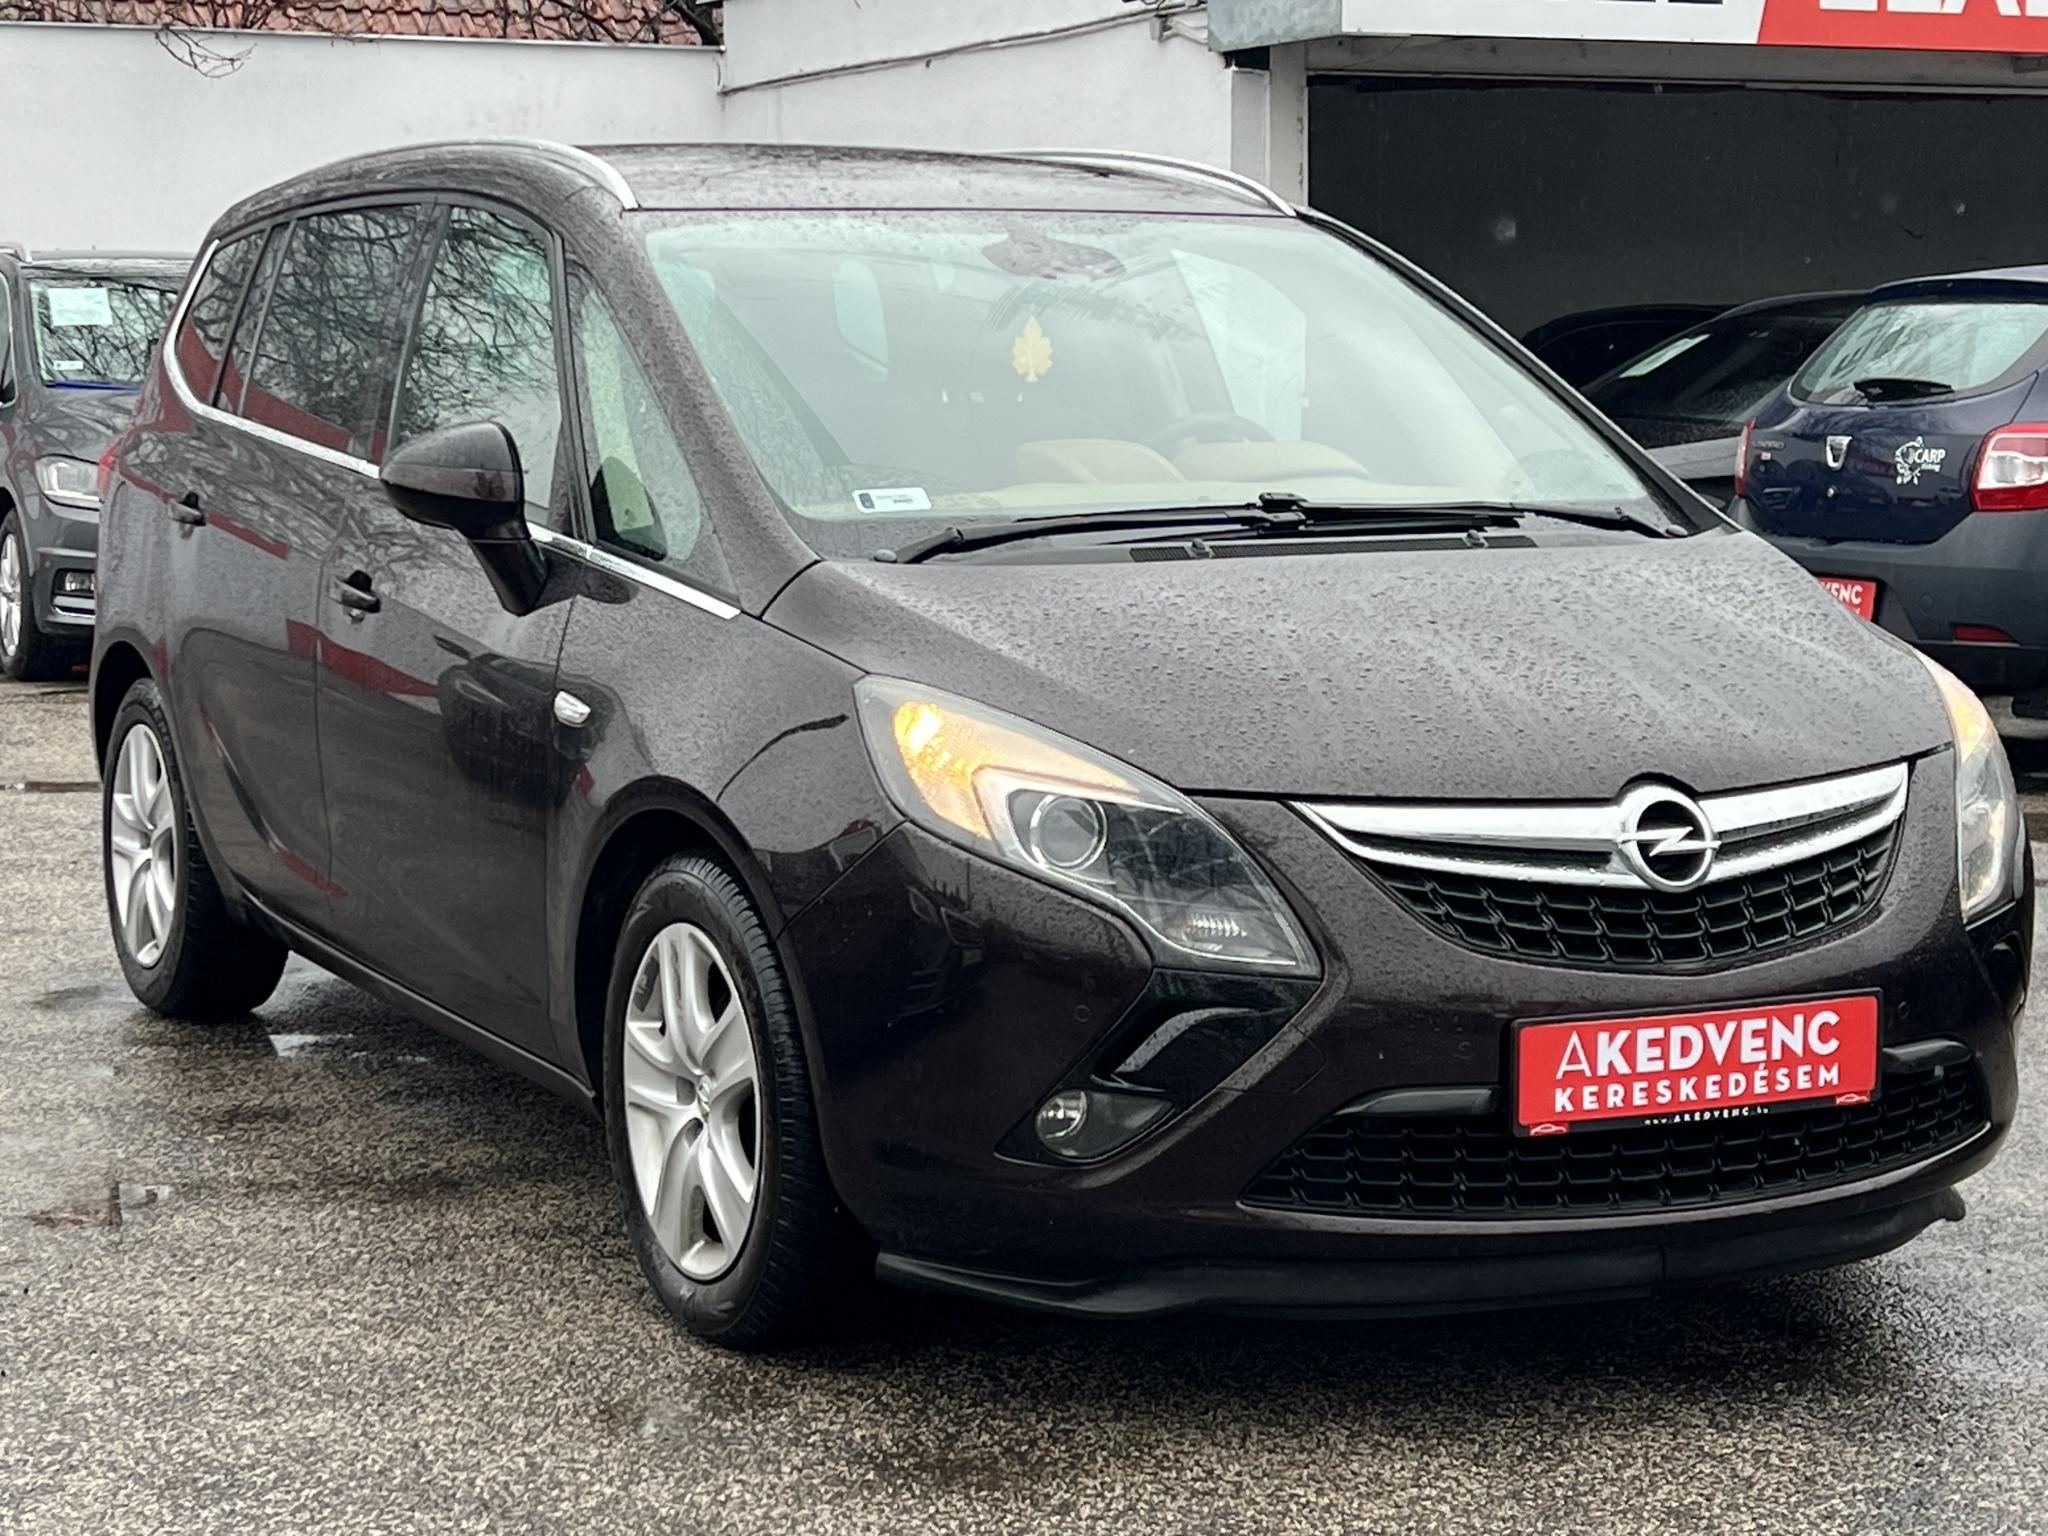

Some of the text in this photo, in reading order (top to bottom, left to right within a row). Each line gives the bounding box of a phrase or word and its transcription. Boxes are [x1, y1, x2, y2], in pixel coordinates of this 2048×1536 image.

[1914, 448, 1946, 463] CARP
[1555, 1011, 1840, 1080] AKEDVENC
[1554, 1062, 1839, 1112] KERESKEDÉSEM
